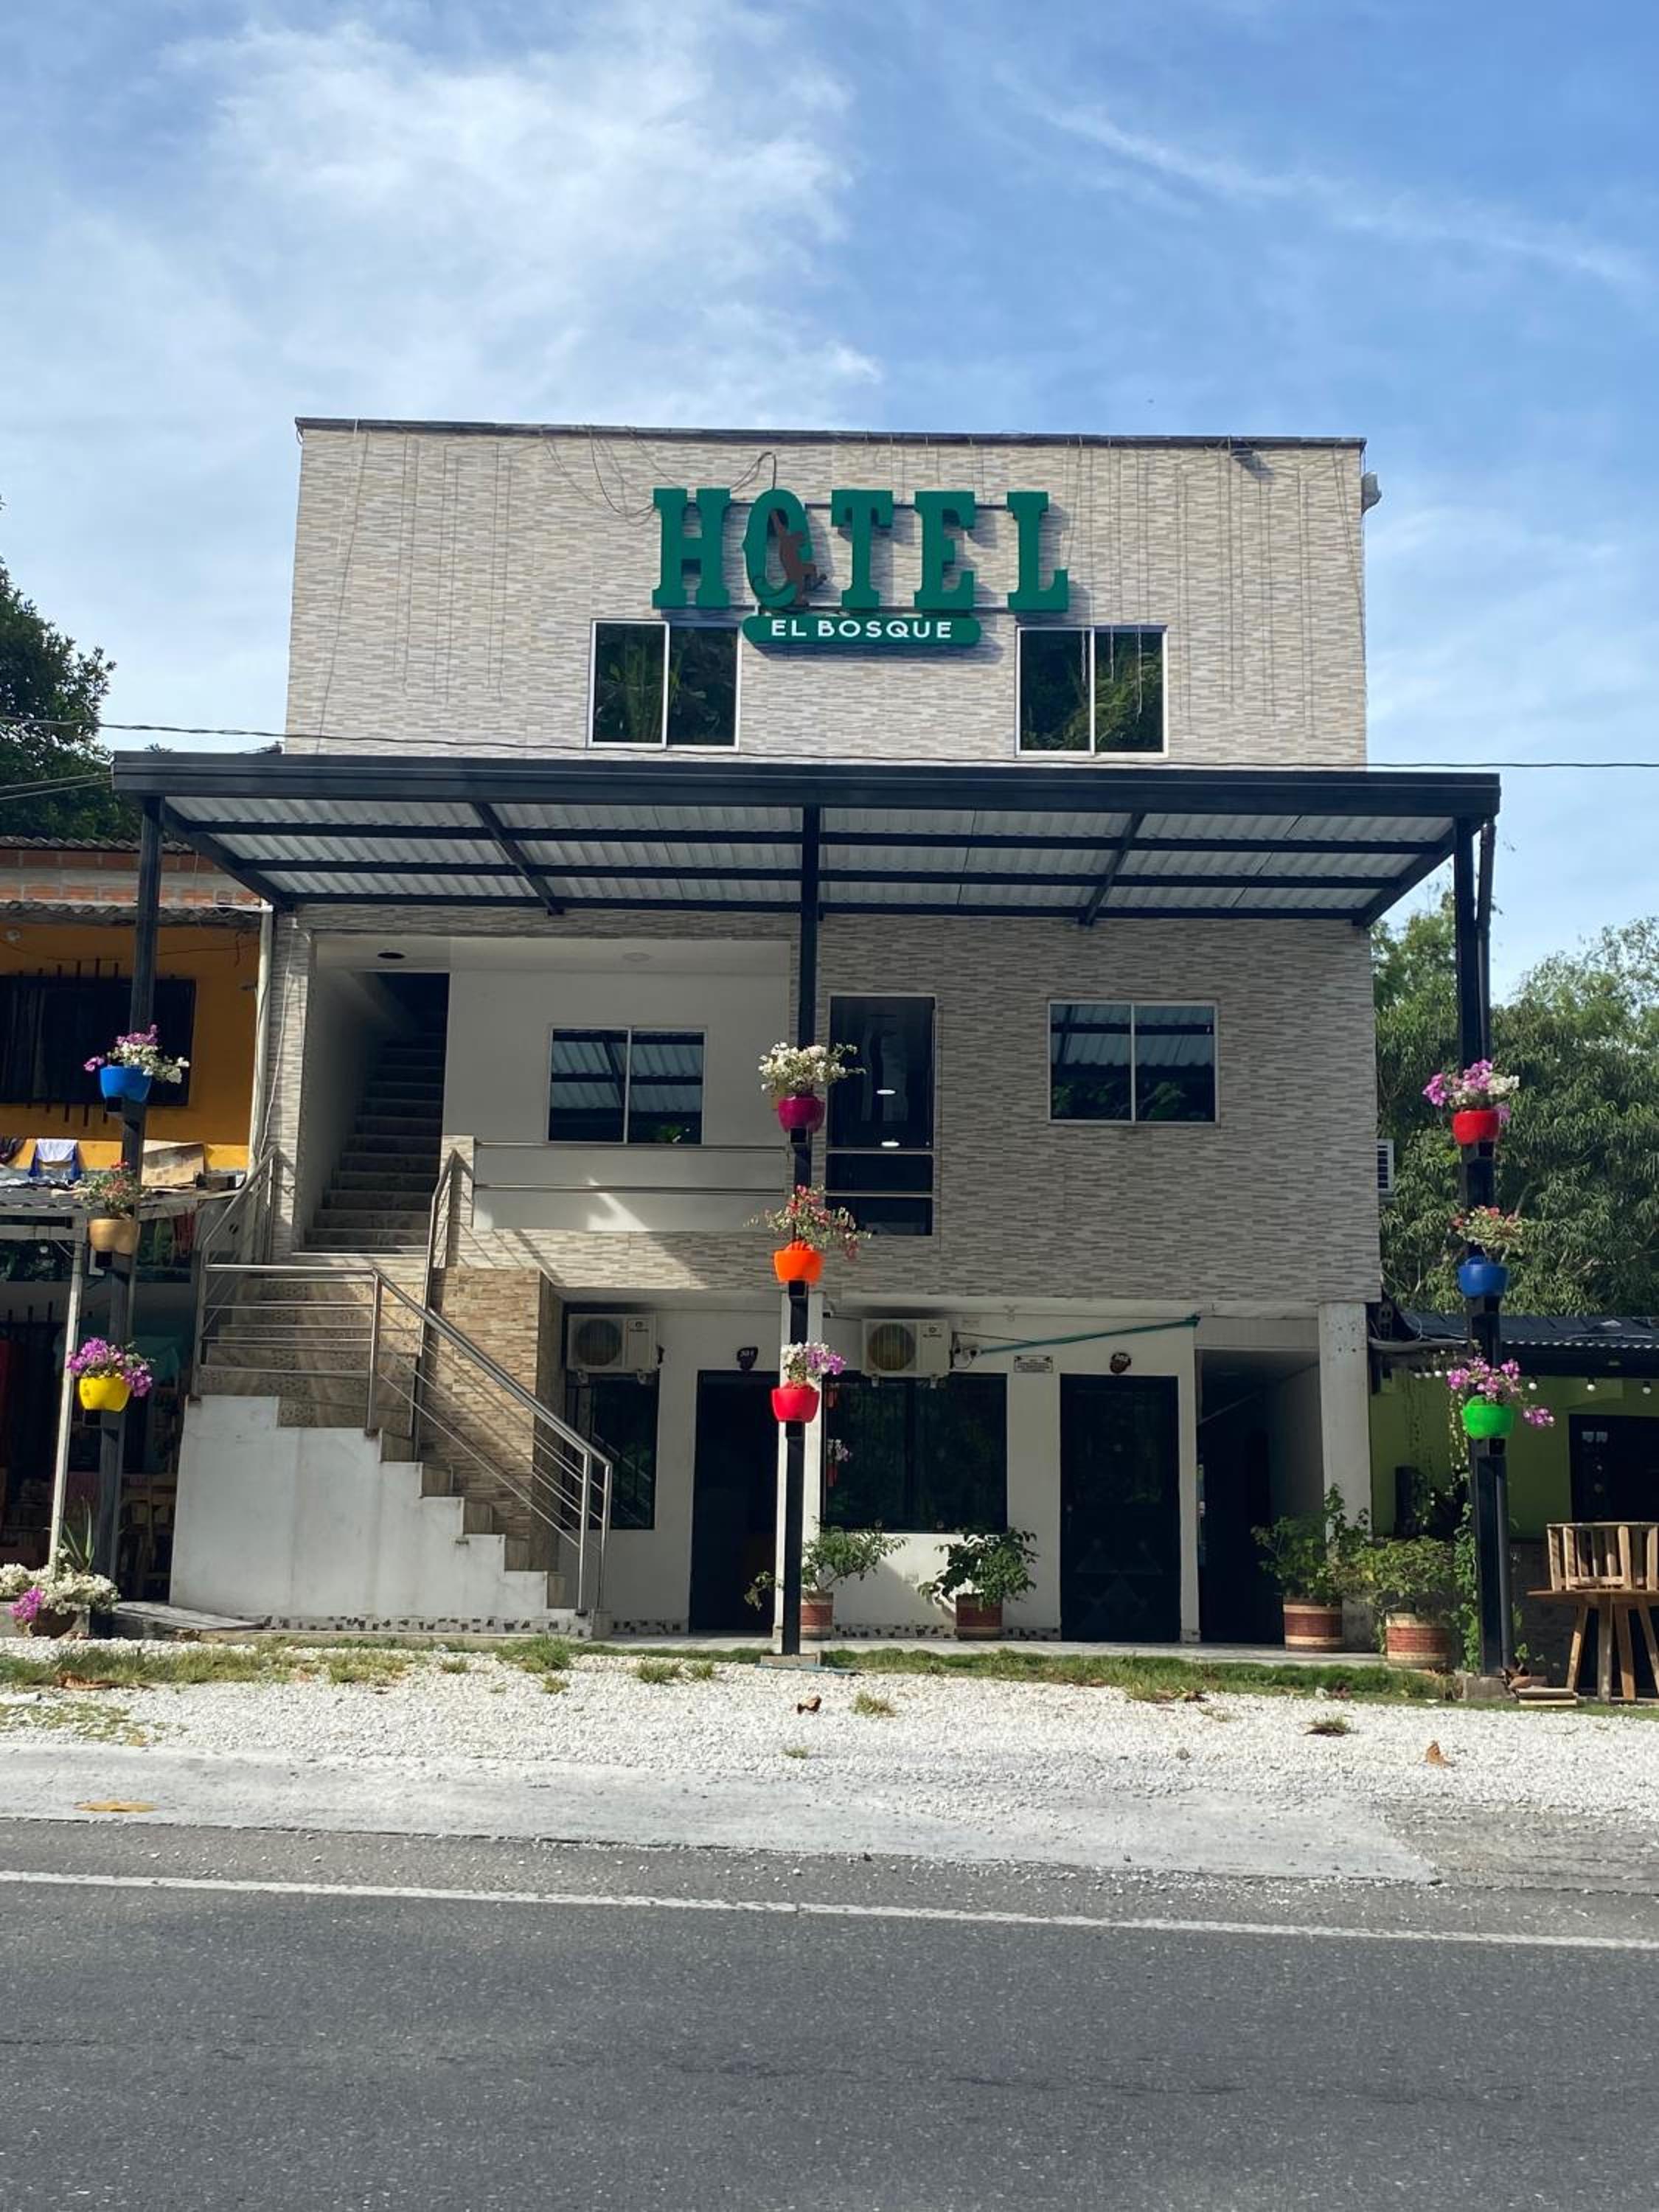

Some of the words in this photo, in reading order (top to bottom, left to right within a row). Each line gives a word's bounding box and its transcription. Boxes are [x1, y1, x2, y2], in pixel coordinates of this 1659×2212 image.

[652, 487, 1069, 612] HOTEL
[771, 619, 807, 637] EL
[817, 620, 953, 639] BOSQUE
